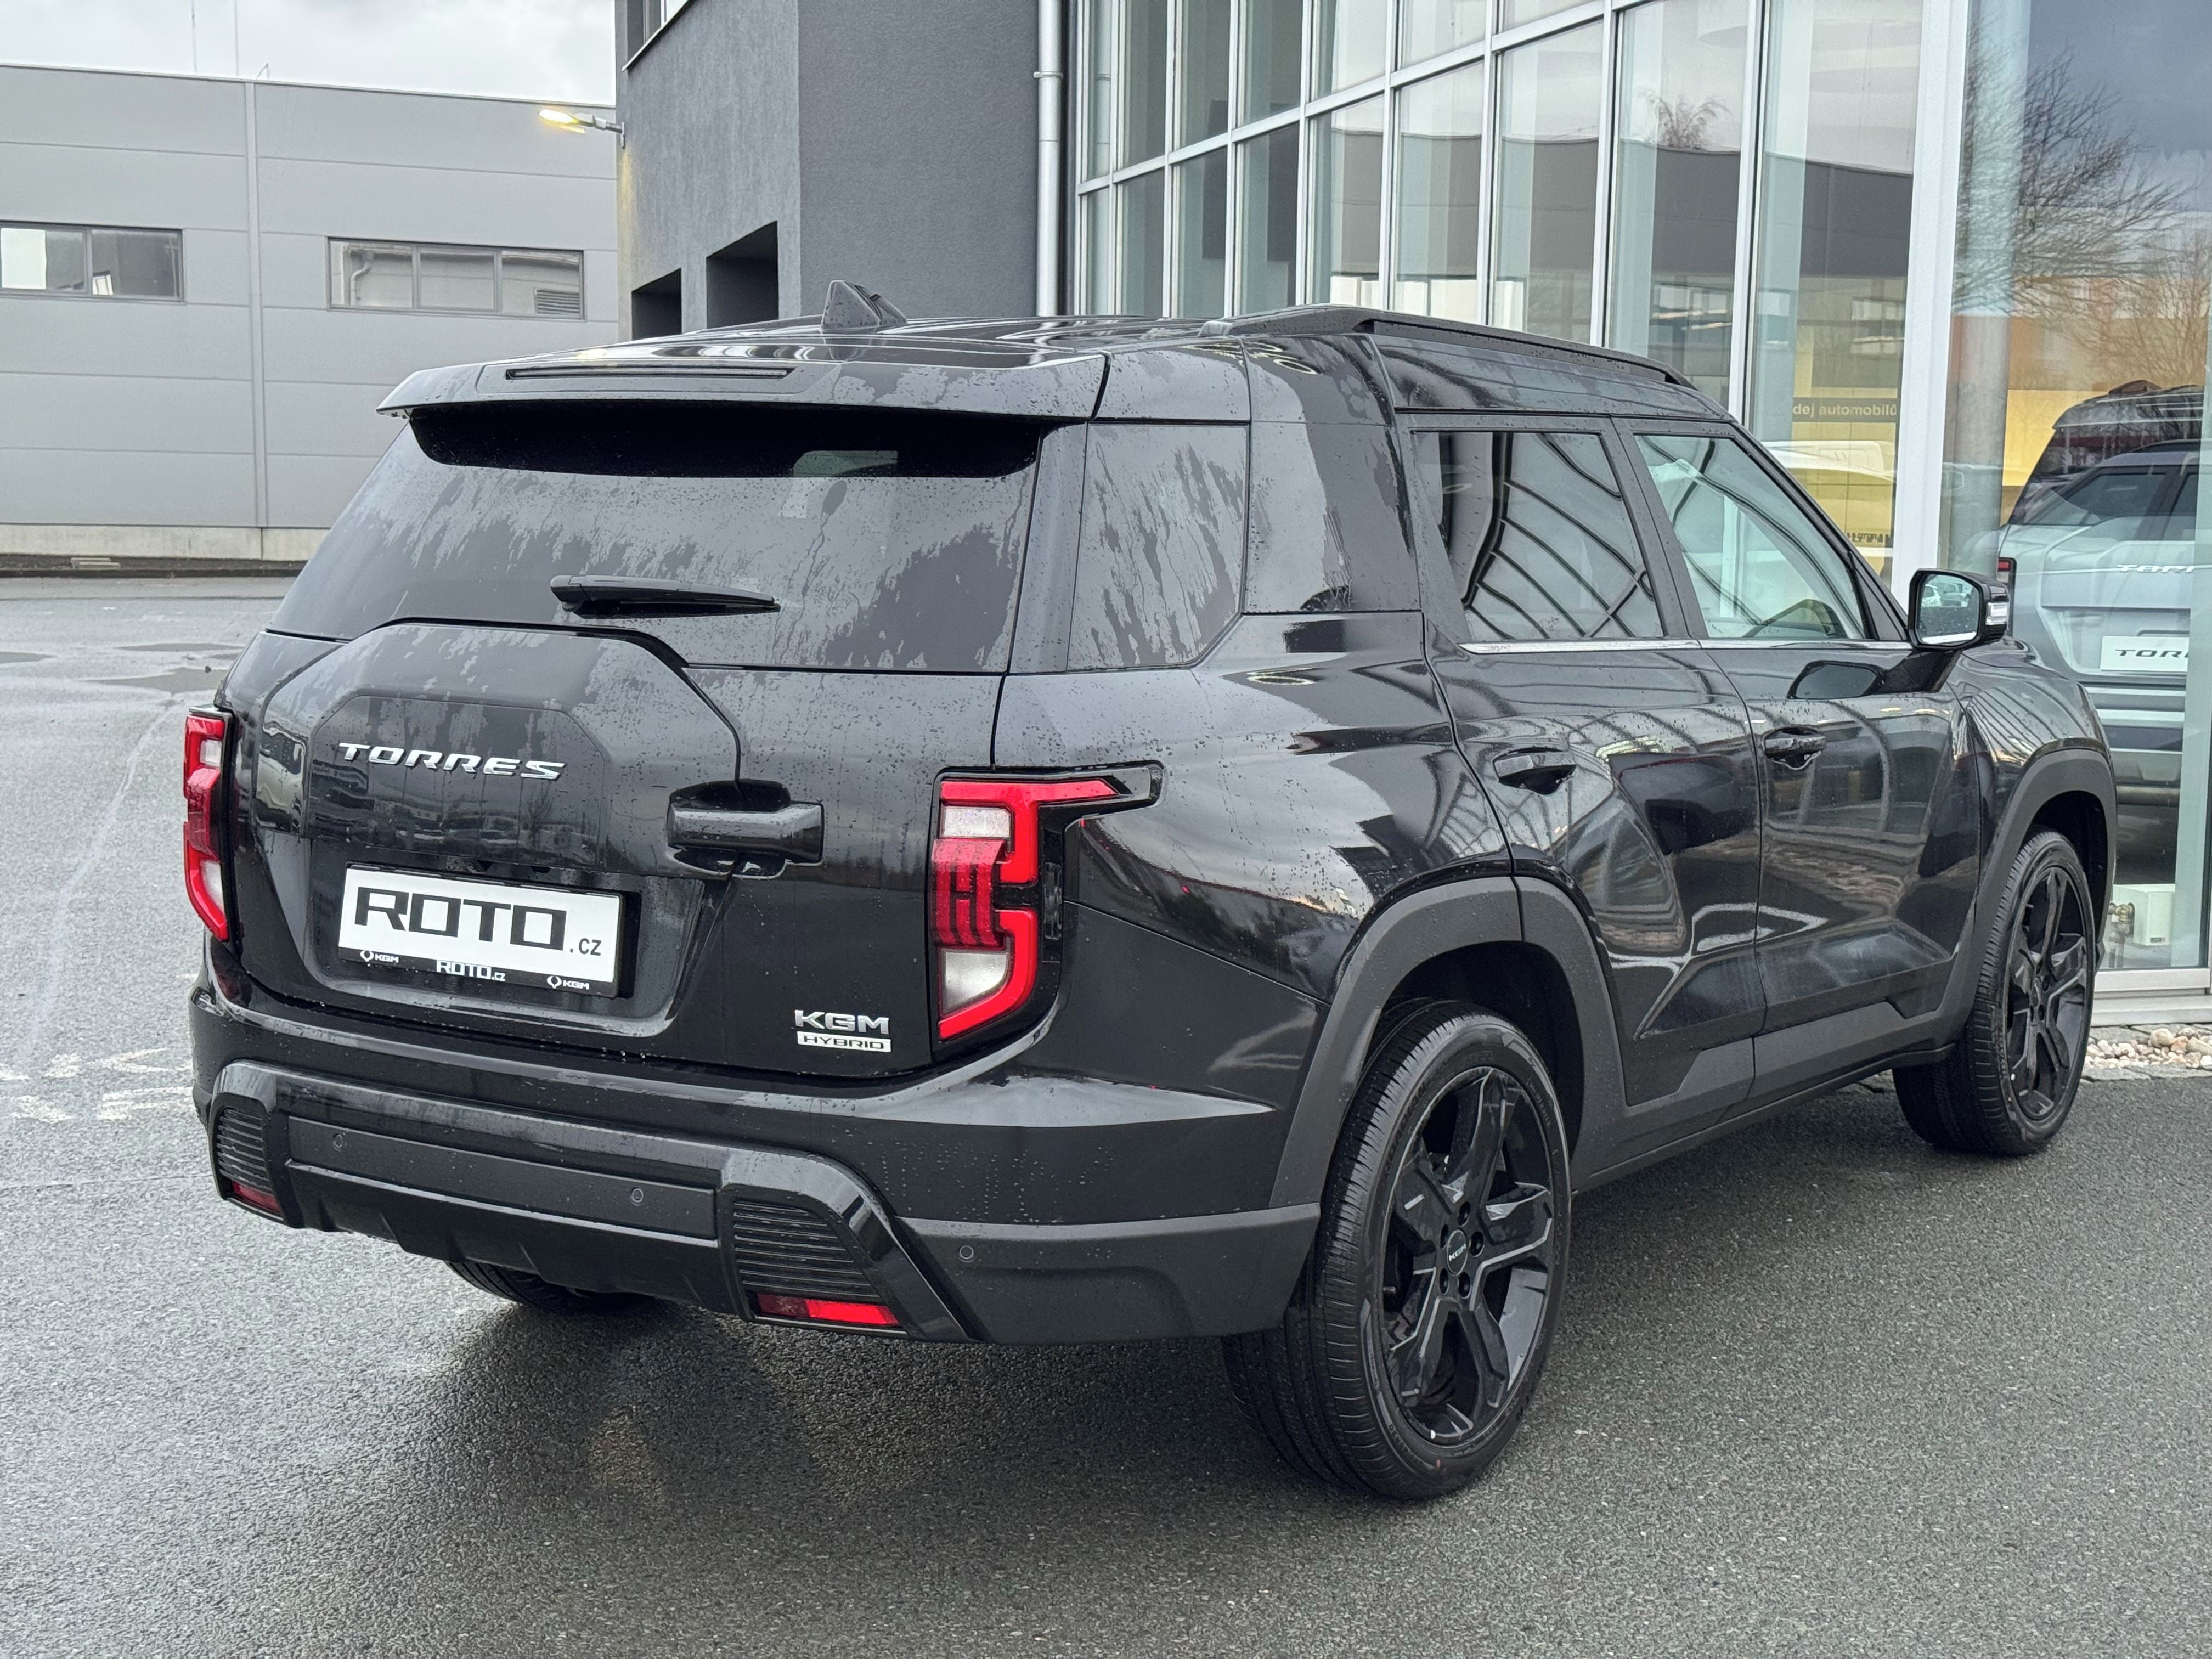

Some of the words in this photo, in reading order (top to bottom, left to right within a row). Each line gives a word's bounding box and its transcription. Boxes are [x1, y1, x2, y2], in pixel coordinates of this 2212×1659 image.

[2115, 649, 2189, 658] TOR
[339, 742, 566, 780] TORRES
[375, 953, 399, 963] KGM
[563, 979, 590, 990] KGM
[794, 1009, 889, 1035] KGM
[804, 1035, 884, 1049] HYBRID
